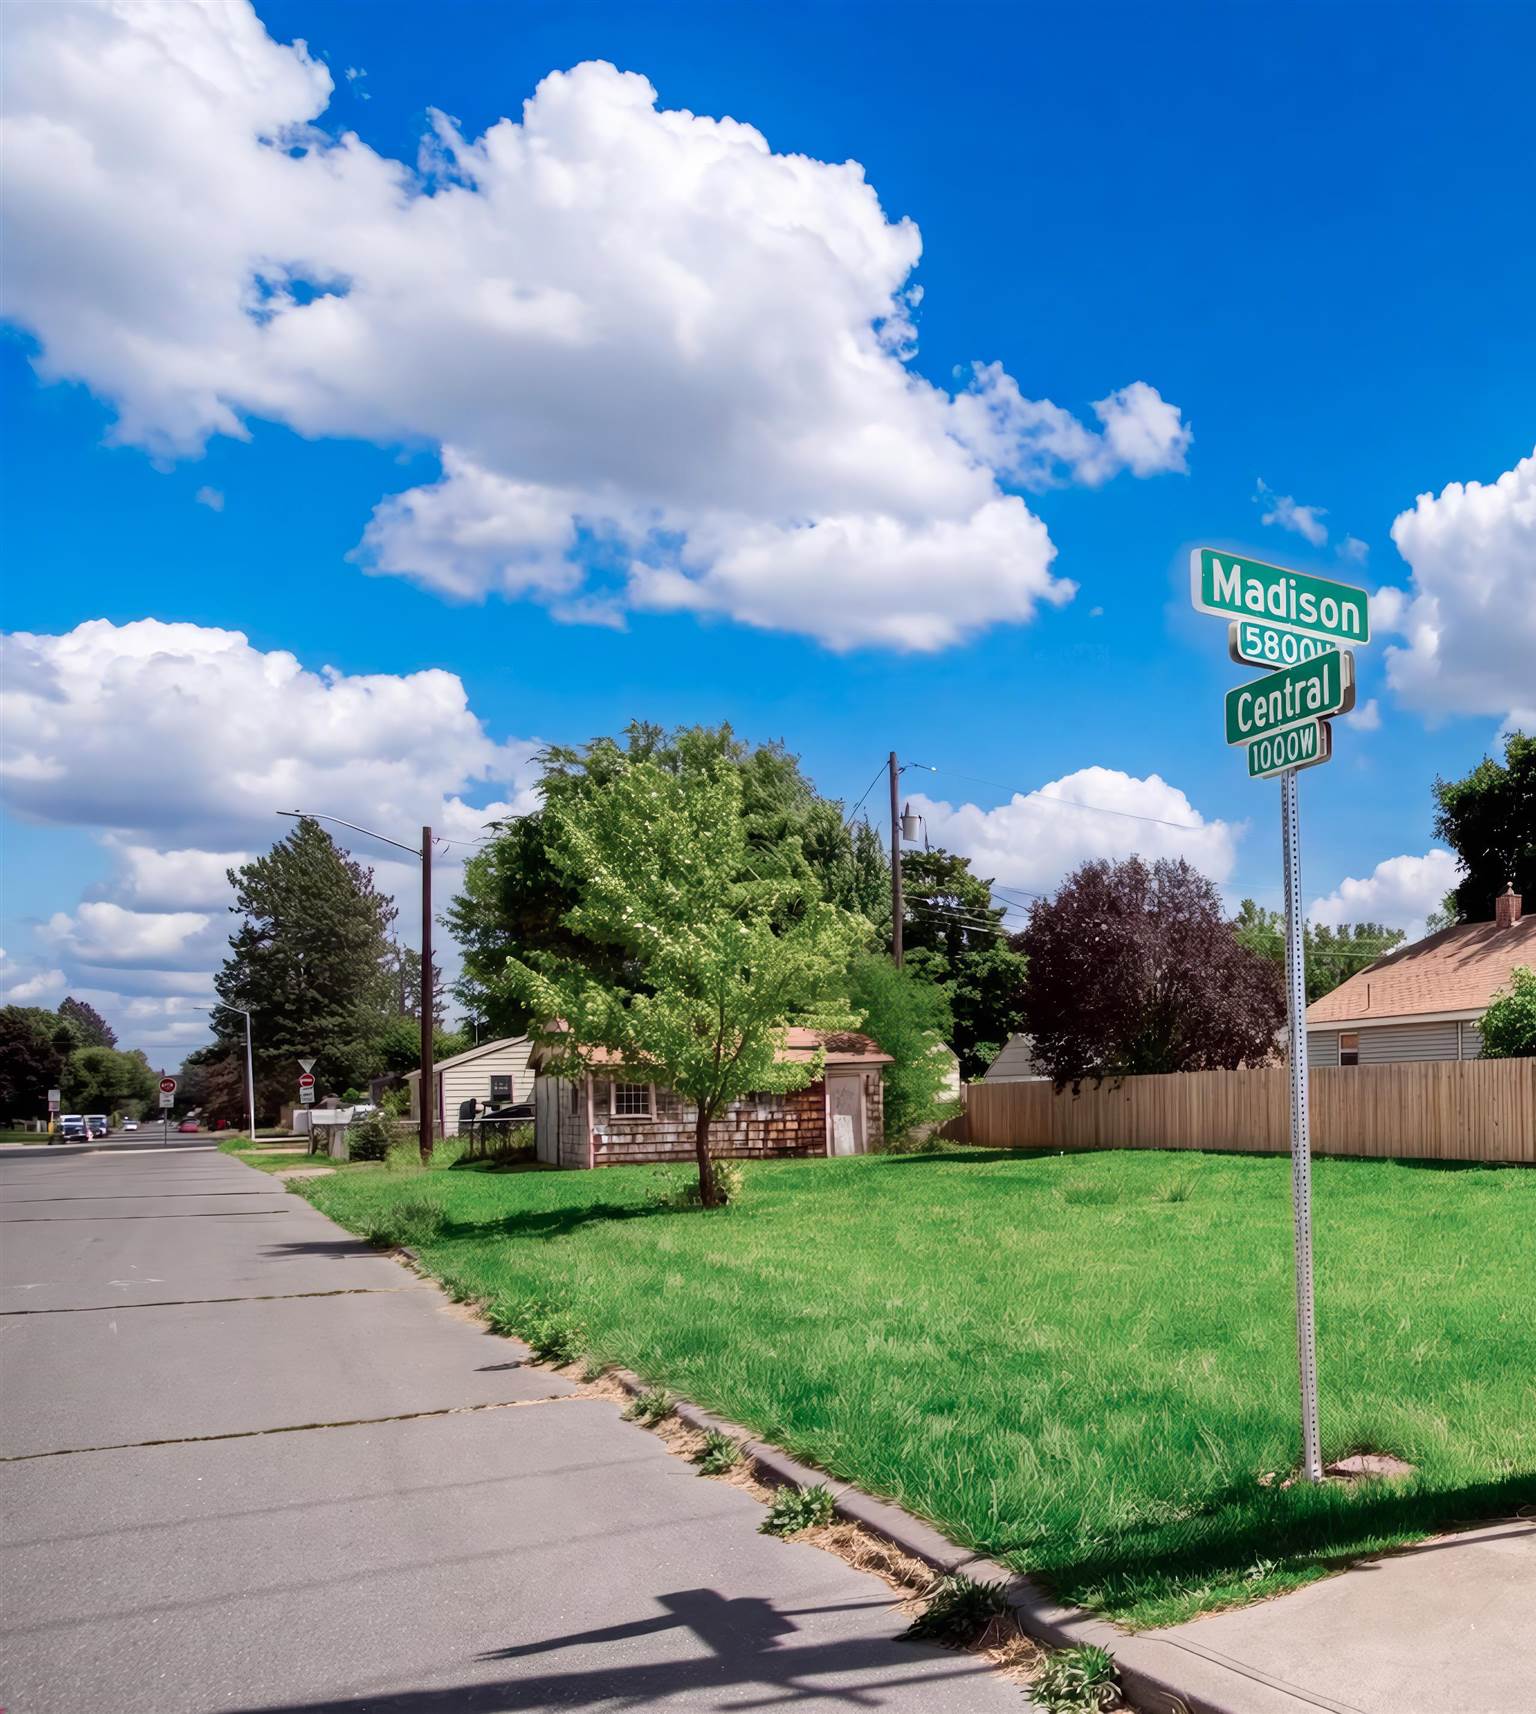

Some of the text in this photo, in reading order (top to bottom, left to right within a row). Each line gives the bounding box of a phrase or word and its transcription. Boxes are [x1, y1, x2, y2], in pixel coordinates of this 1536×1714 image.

[1212, 558, 1360, 633] Madison
[1237, 664, 1330, 733] Central
[1252, 726, 1314, 771] 1000W
